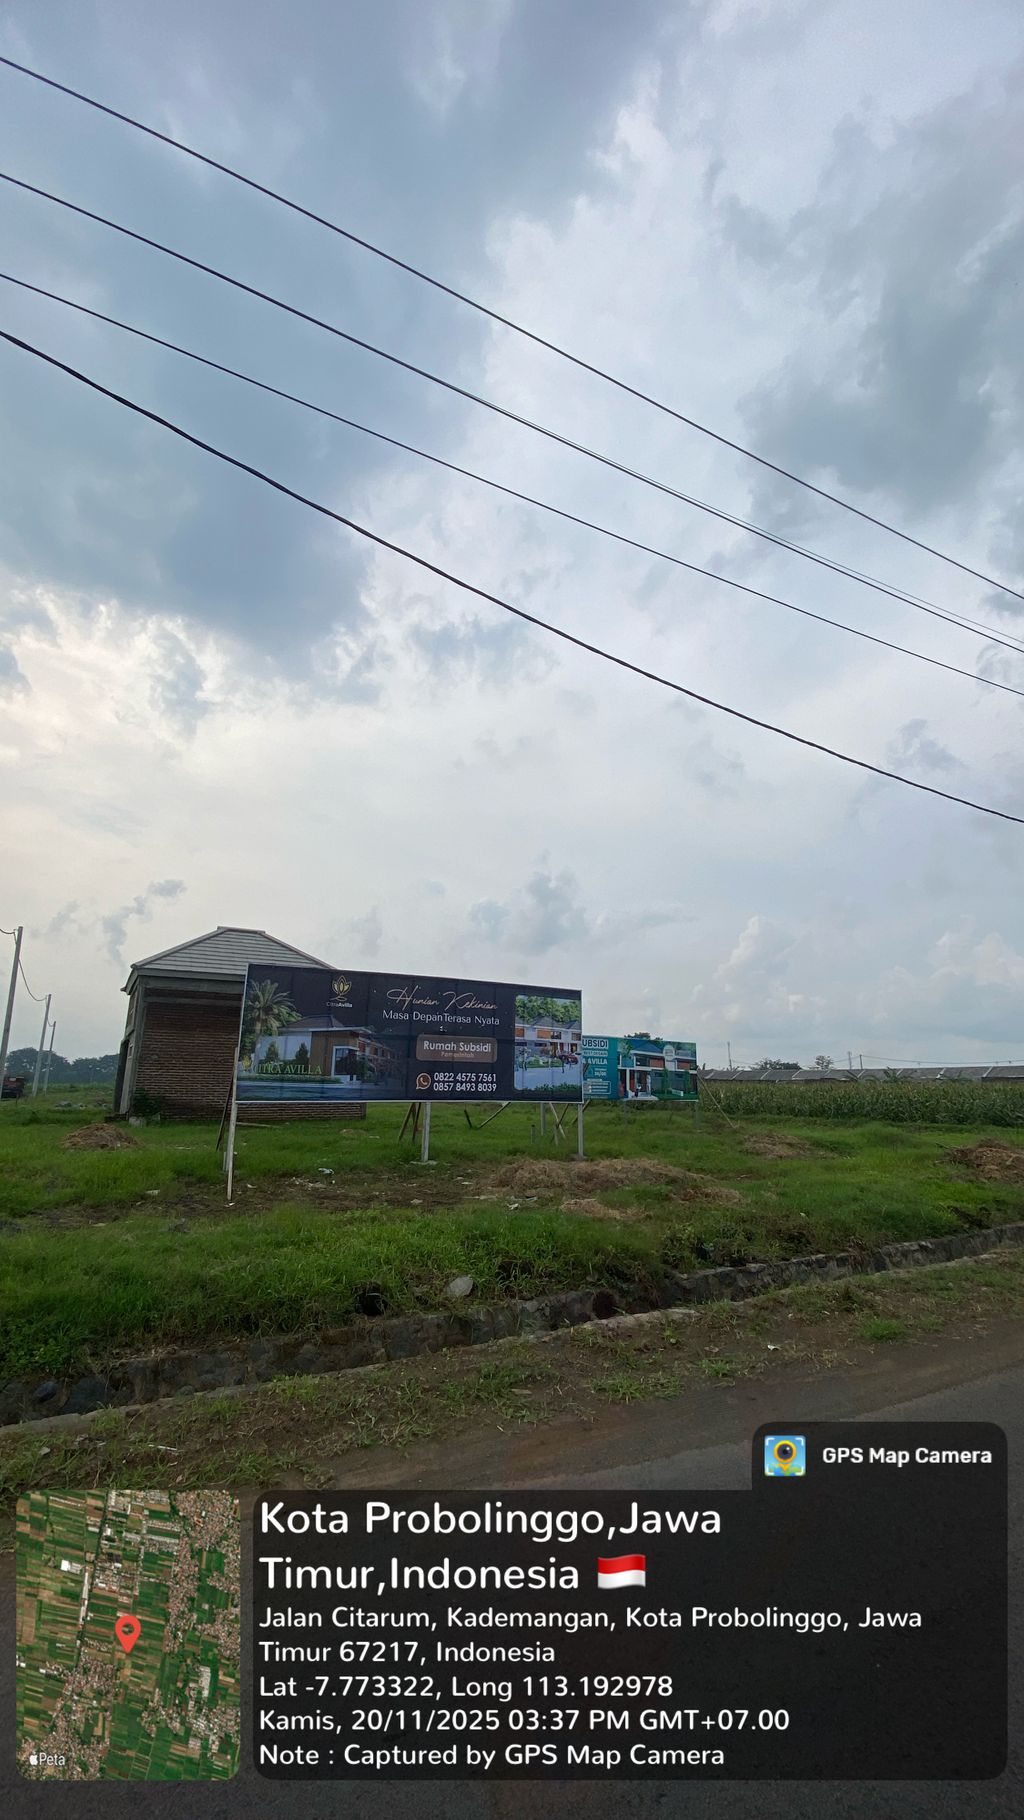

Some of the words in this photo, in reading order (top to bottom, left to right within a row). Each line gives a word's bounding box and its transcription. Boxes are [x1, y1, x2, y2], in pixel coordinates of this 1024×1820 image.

[386, 985, 440, 1010] Hunian
[442, 991, 498, 1011] Kekinian
[382, 1009, 409, 1020] Masa
[474, 1015, 500, 1027] Nyata
[423, 1040, 457, 1051] Rumah
[459, 1041, 492, 1053] Subsidi
[283, 1064, 323, 1075] AVILLA
[433, 1072, 455, 1082] 0822
[456, 1073, 476, 1082] 4575
[478, 1073, 497, 1082] 7561
[433, 1082, 453, 1091] 0857
[455, 1083, 476, 1092] 8493
[477, 1083, 497, 1092] 8039
